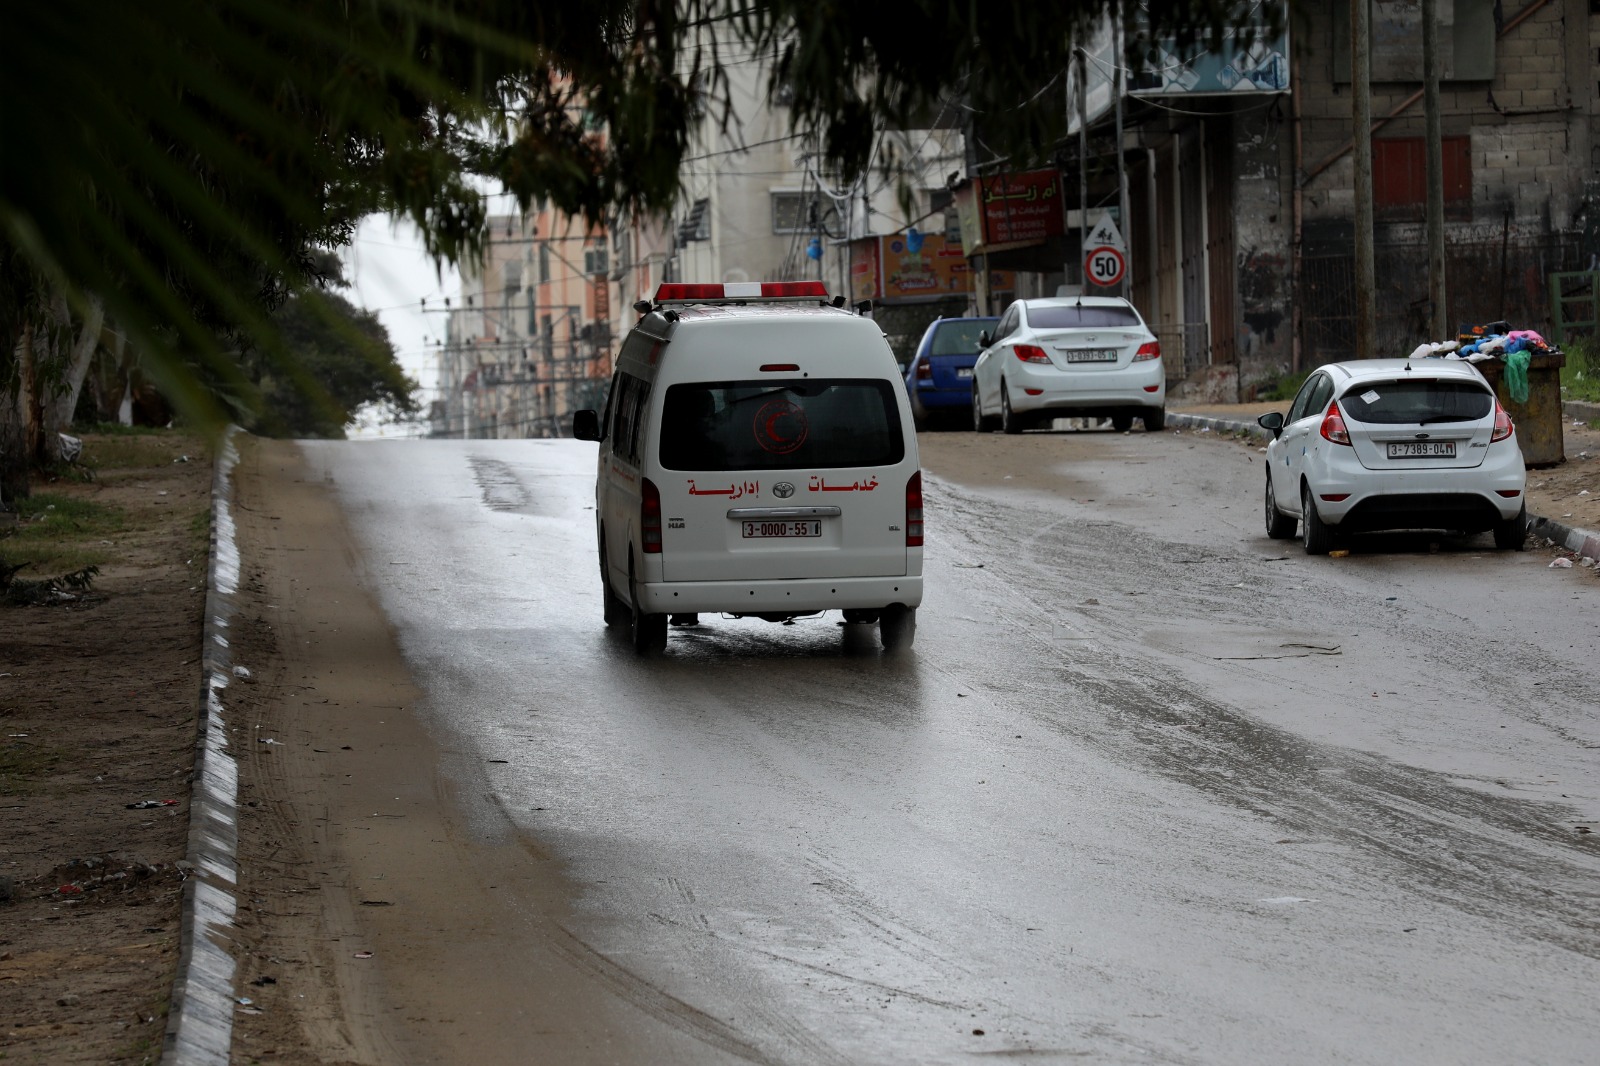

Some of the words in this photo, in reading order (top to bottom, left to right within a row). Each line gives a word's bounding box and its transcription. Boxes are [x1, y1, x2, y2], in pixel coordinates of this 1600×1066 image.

[1041, 177, 1057, 200] أم
[1095, 256, 1117, 277] 50
[1391, 443, 1445, 455] 3-7389-04
[687, 479, 759, 499] إدارية
[808, 475, 879, 492] خدمات
[747, 522, 807, 536] 3-0000-55
